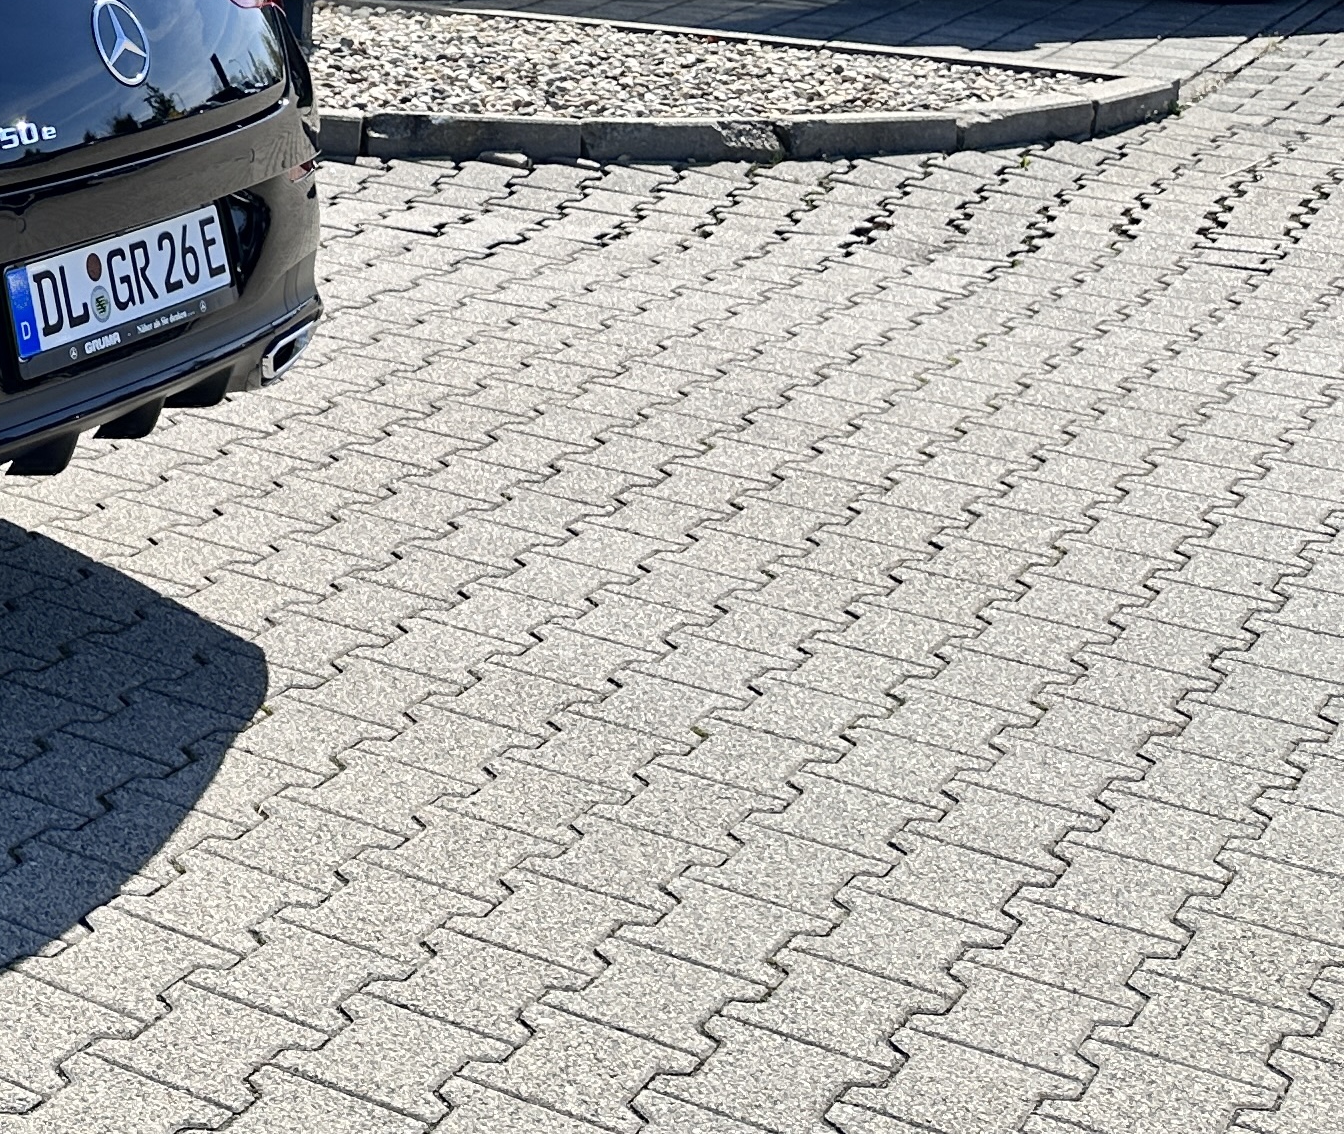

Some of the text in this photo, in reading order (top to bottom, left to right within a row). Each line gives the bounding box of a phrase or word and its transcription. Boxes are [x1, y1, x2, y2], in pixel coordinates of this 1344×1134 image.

[33, 267, 90, 337] DL
[106, 240, 159, 311] GR
[21, 321, 31, 340] D
